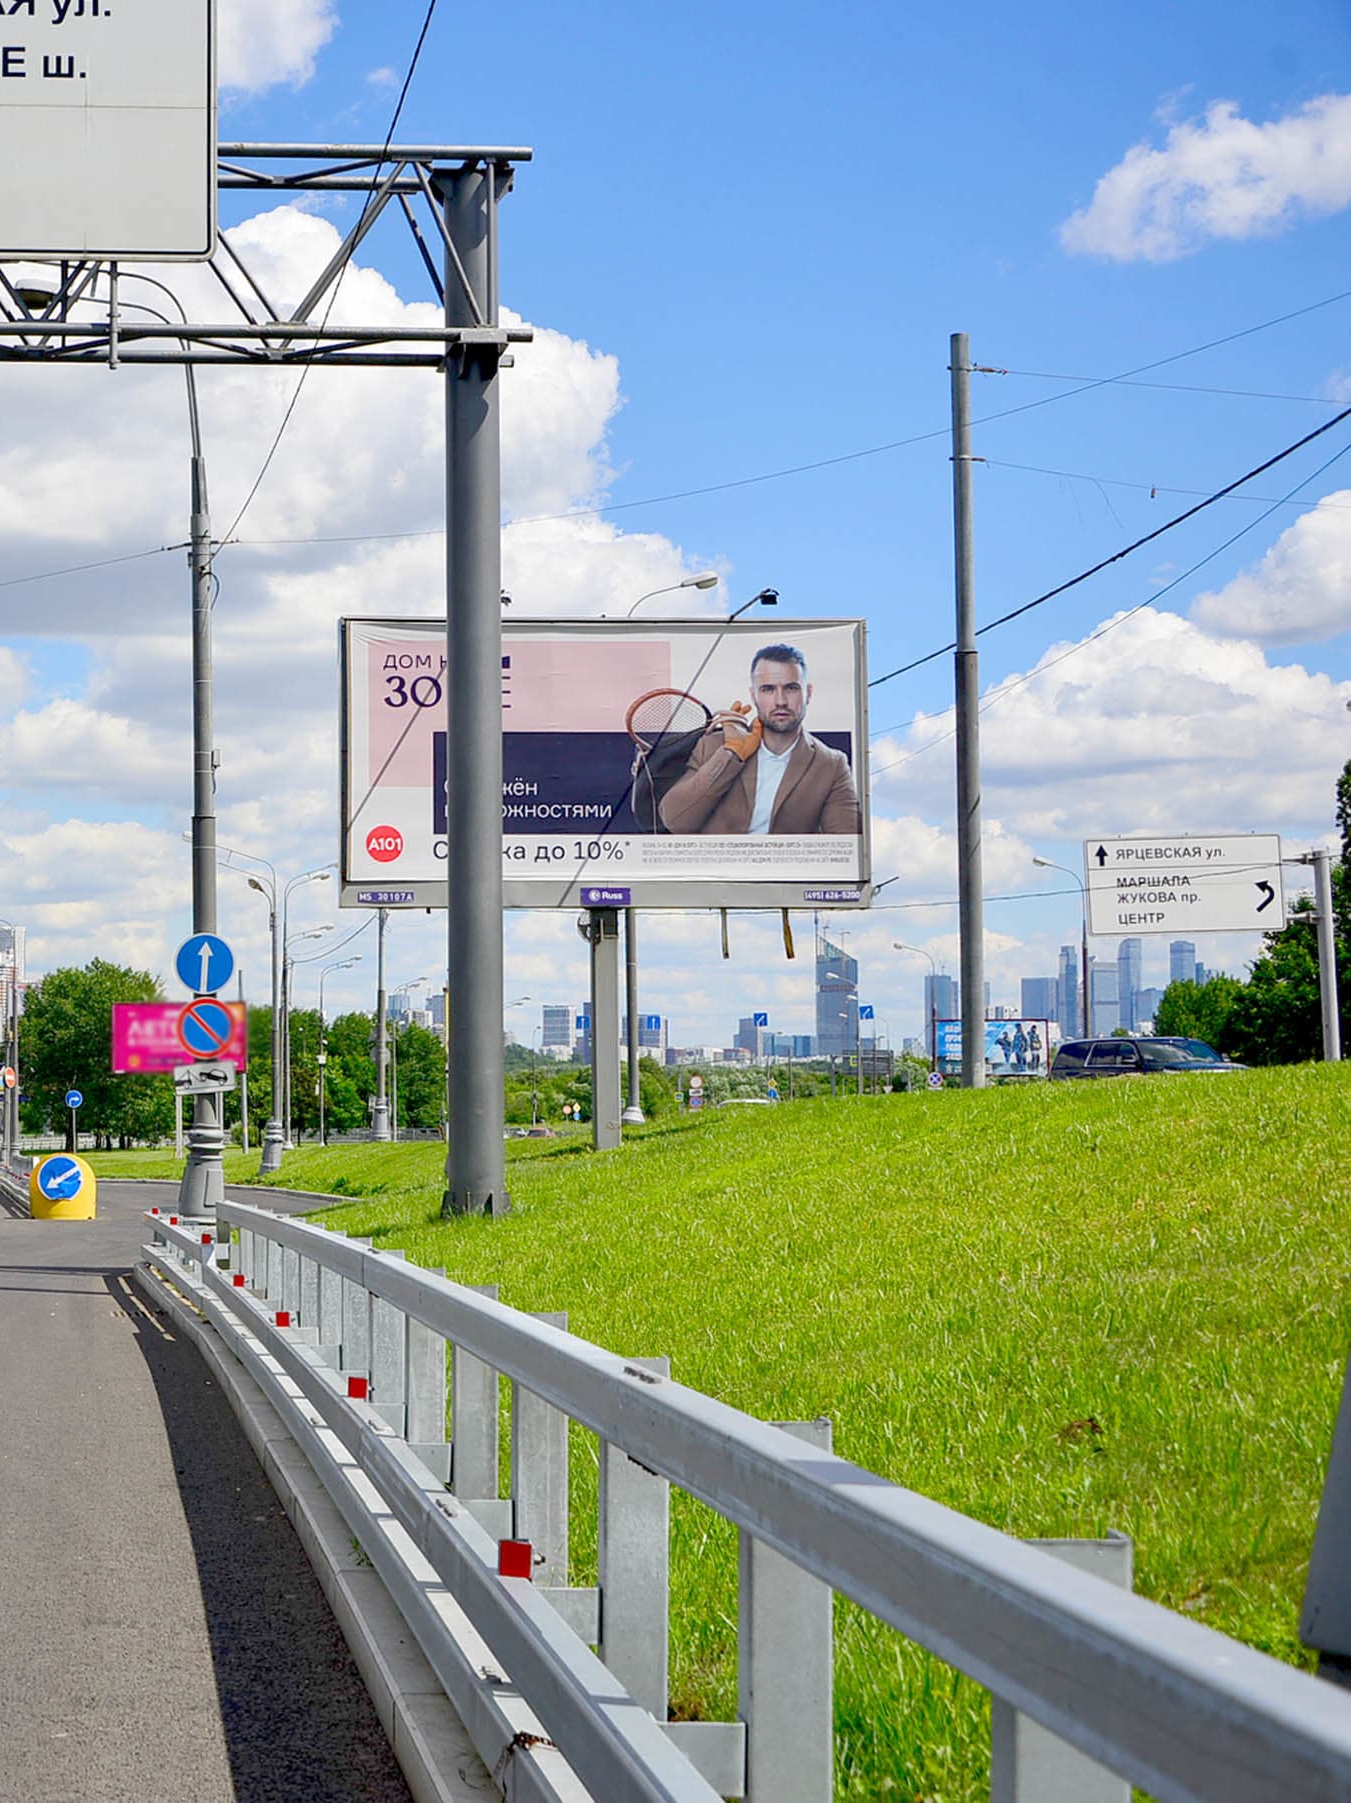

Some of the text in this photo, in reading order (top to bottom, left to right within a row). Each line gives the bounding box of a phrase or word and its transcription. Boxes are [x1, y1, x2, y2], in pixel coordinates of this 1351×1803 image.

[43, 54, 87, 79] ш.
[383, 654, 432, 671] ДОМ
[534, 843, 566, 863] до
[1115, 846, 1226, 861] ЯРЦЕВСКАЯ ул.
[1116, 875, 1191, 888] МАРШАЛА
[601, 891, 623, 900] Russ
[1117, 891, 1201, 904] ЖУКОВА пр.
[1118, 912, 1165, 926] ЦЕНТР
